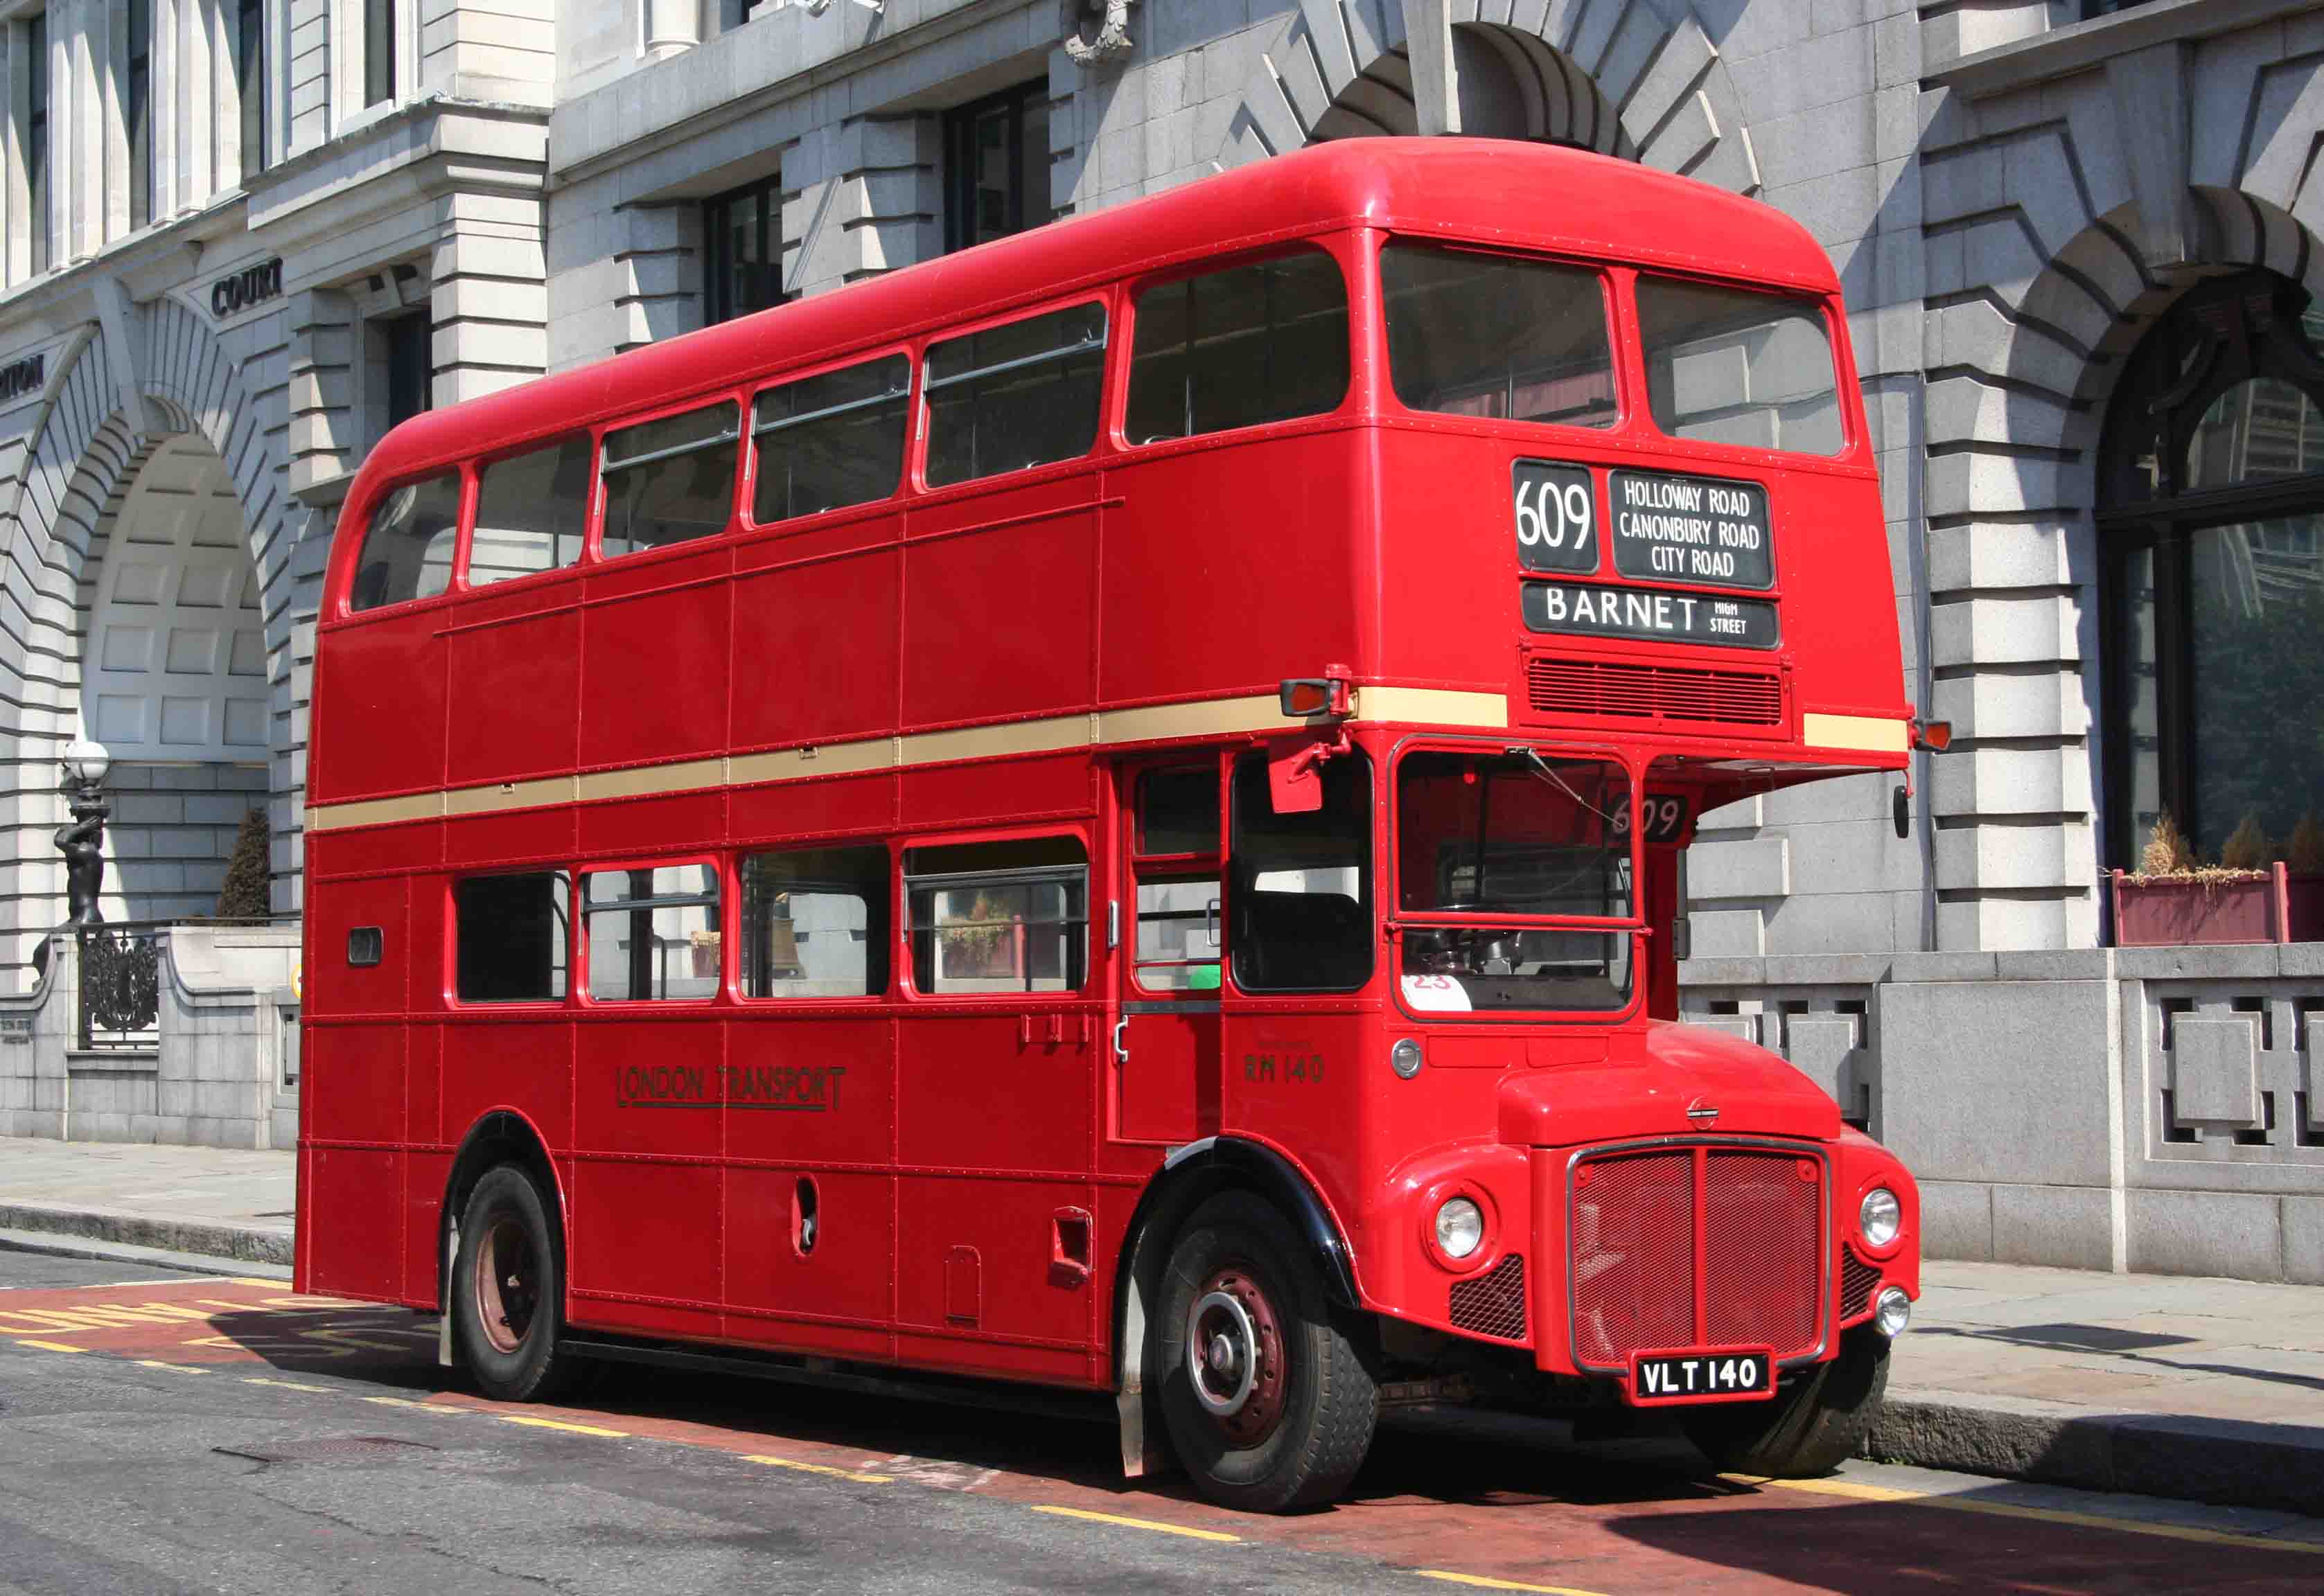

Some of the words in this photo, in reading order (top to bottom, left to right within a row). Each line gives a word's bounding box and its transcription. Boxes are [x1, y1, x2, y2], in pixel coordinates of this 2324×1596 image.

[211, 257, 283, 316] COURT
[1515, 480, 1591, 550] 609
[1623, 480, 1702, 513] HOLLOWAY
[1709, 488, 1750, 517] ROAD
[1619, 512, 1711, 545] CANONBURY
[1718, 520, 1759, 549] ROAD
[1651, 546, 1685, 573] CITY
[1691, 549, 1734, 576] ROAD
[1547, 588, 1697, 630] BARNET
[1709, 617, 1747, 635] STREET
[1714, 601, 1738, 617] HIGH
[1612, 799, 1679, 835] 609
[1243, 1054, 1276, 1083] RM
[1285, 1054, 1325, 1085] 140
[615, 1065, 704, 1108] LONDON
[714, 1065, 847, 1112] TRANSPORT
[1643, 1360, 1699, 1393] VLT
[1709, 1358, 1757, 1389] 140
